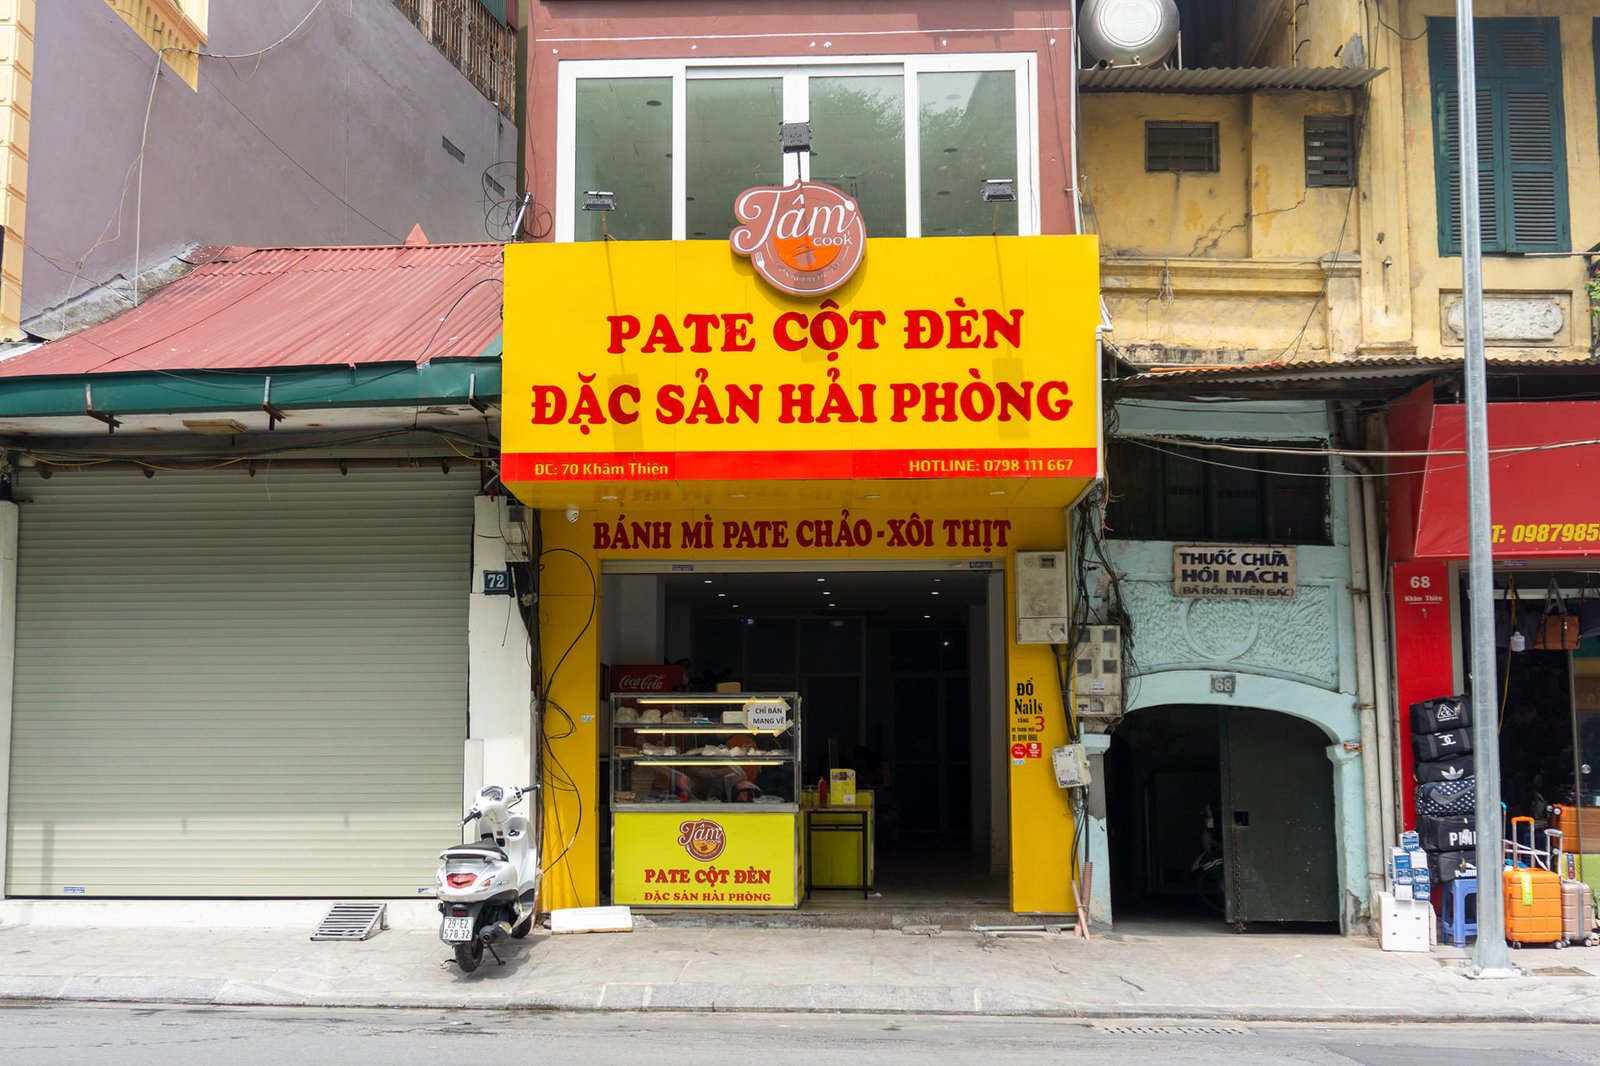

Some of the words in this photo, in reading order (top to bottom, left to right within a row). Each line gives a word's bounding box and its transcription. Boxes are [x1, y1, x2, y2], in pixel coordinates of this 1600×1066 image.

[733, 182, 858, 252] Tâm
[813, 233, 853, 247] cook
[606, 313, 756, 354] PATE
[773, 299, 886, 362] CỘT
[903, 297, 1024, 350] ĐÈN
[531, 371, 641, 435] ĐẶC
[656, 367, 763, 424] SẢN
[778, 367, 878, 424] HẢI
[890, 368, 1074, 423] PHÒNG
[534, 463, 558, 476] ĐC:
[561, 463, 579, 476] 70
[583, 462, 625, 476] Khâm
[628, 462, 669, 476] Thiên
[909, 460, 980, 473] HOTLINE:
[983, 459, 1020, 472] 0798
[1023, 459, 1044, 471] 111
[1047, 459, 1074, 472] 667
[593, 514, 672, 549] BÁNH
[681, 514, 714, 549] MÌ
[722, 520, 789, 549] PATE
[943, 519, 1011, 553] THỊT
[1511, 523, 1600, 543] 0987985
[1179, 549, 1237, 566] THUỐC
[1241, 550, 1289, 566] CHỮA
[487, 574, 505, 588] 72
[1181, 566, 1219, 582] HÔI
[1226, 567, 1289, 583] NÁCH
[1410, 576, 1430, 588] 68
[1214, 678, 1233, 692] 68
[1014, 699, 1043, 714] Nails
[1035, 716, 1045, 732] 3
[678, 819, 724, 846] Tâm
[645, 869, 691, 884] PATE
[694, 865, 730, 888] CỘT
[733, 866, 771, 884] ĐÈN
[644, 891, 671, 903] ĐẶC
[672, 890, 699, 901] SẢN
[702, 890, 725, 901] HẢI
[728, 891, 772, 902] PHÒNG
[444, 929, 471, 940] 578.32
